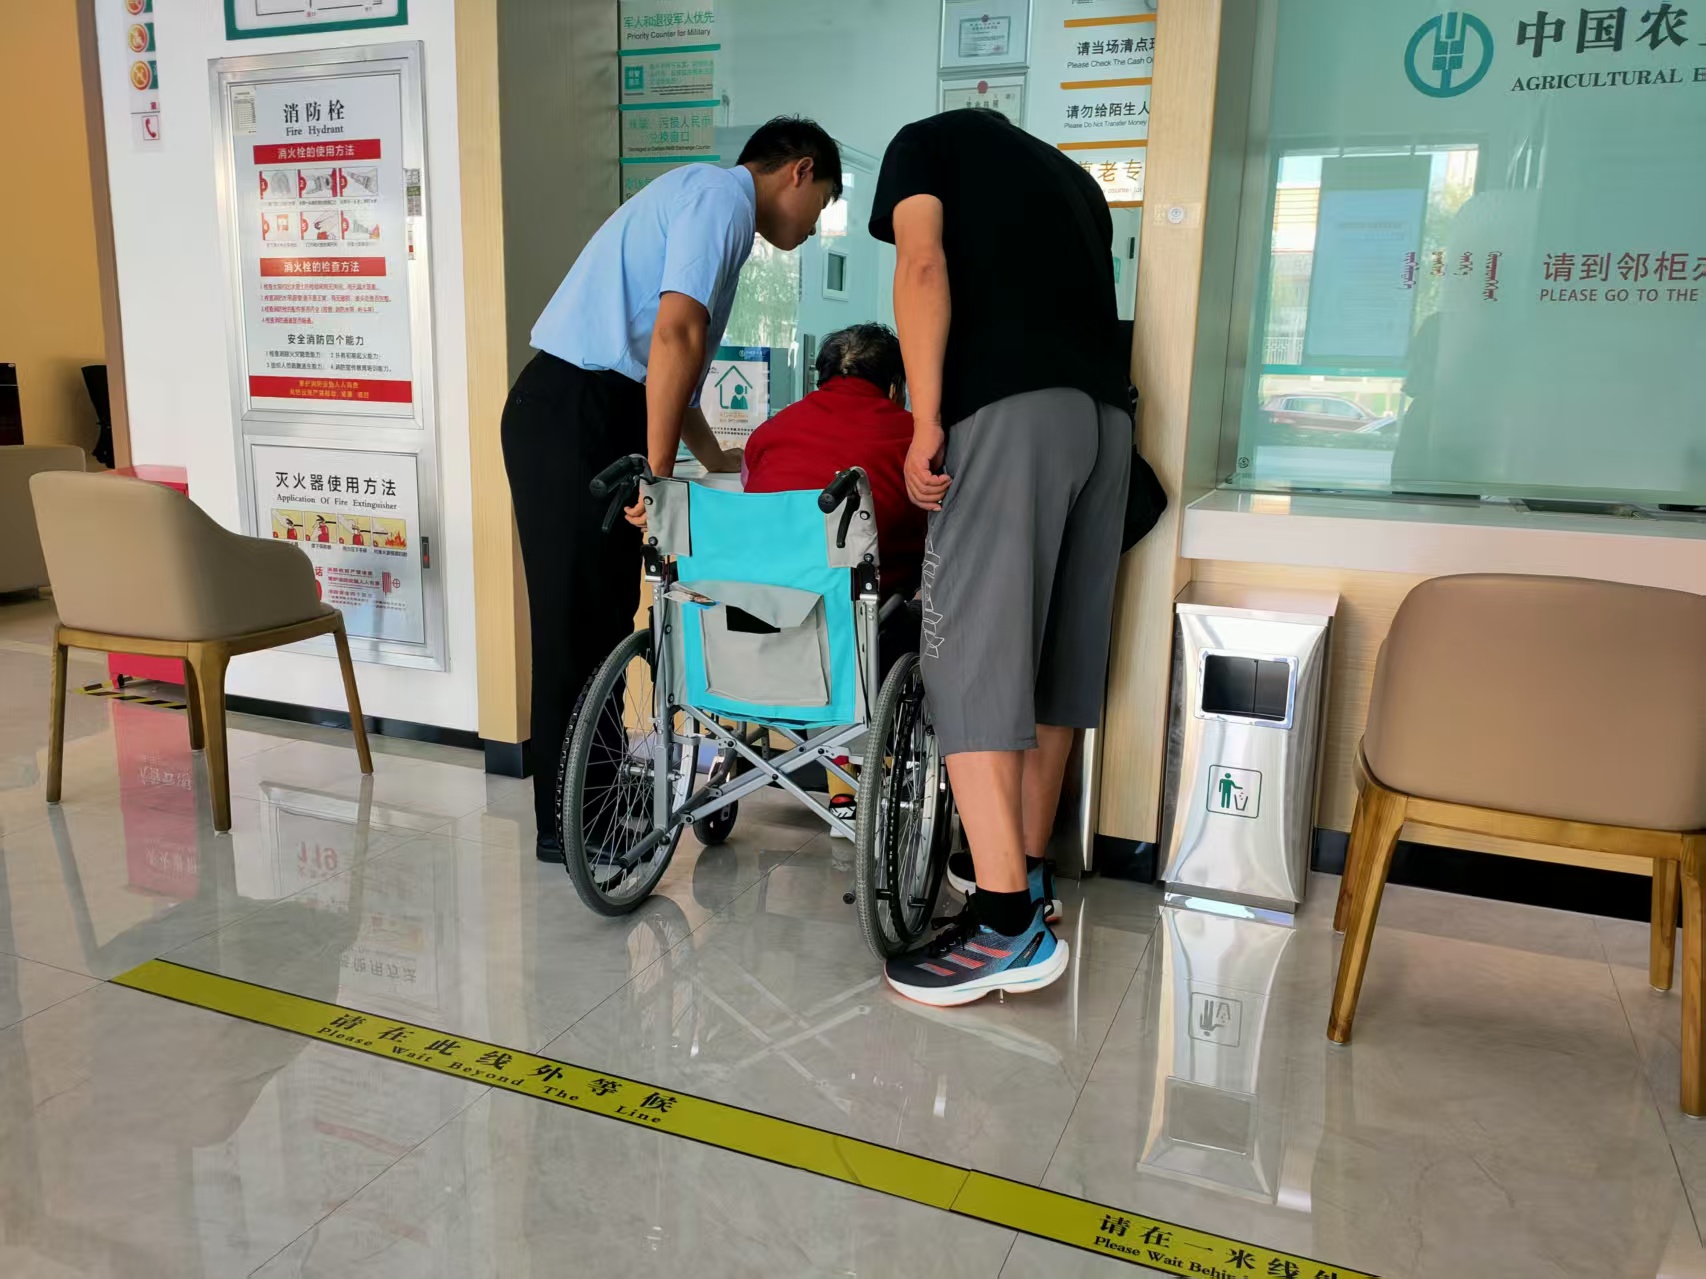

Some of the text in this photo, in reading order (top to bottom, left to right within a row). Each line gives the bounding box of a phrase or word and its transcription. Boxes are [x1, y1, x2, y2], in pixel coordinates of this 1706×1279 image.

[624, 12, 715, 28] 军人和退役军人优先
[627, 32, 650, 40] Priority
[651, 31, 676, 39] Counter
[687, 28, 711, 37] Military
[1516, 4, 1706, 58] 中国农
[1067, 59, 1090, 69] Please
[1091, 58, 1112, 68] Check
[1113, 58, 1126, 66] The
[1127, 57, 1145, 65] Cash
[1511, 68, 1684, 91] AGRICULTURAL
[283, 99, 345, 124] 消防栓
[1066, 101, 1150, 120] 请勿给陌生人
[286, 124, 344, 136] Fire Hydrant
[1103, 120, 1127, 128] Transfer
[278, 144, 355, 160] 消火栓的使用方法
[284, 260, 360, 273] 消火栓的检查方法
[1540, 289, 1699, 301] PLEASE GO TO THE
[287, 334, 364, 346] 安全消防四个能力
[275, 471, 397, 497] 灭火器使用方法
[276, 493, 398, 510] Application Of Fire Extinguisher
[328, 1013, 678, 1114] 请在此线外等候
[316, 1027, 663, 1124] Please Wait Beyond The Line
[1094, 1235, 1140, 1256] Please
[1147, 1250, 1184, 1269] Wait
